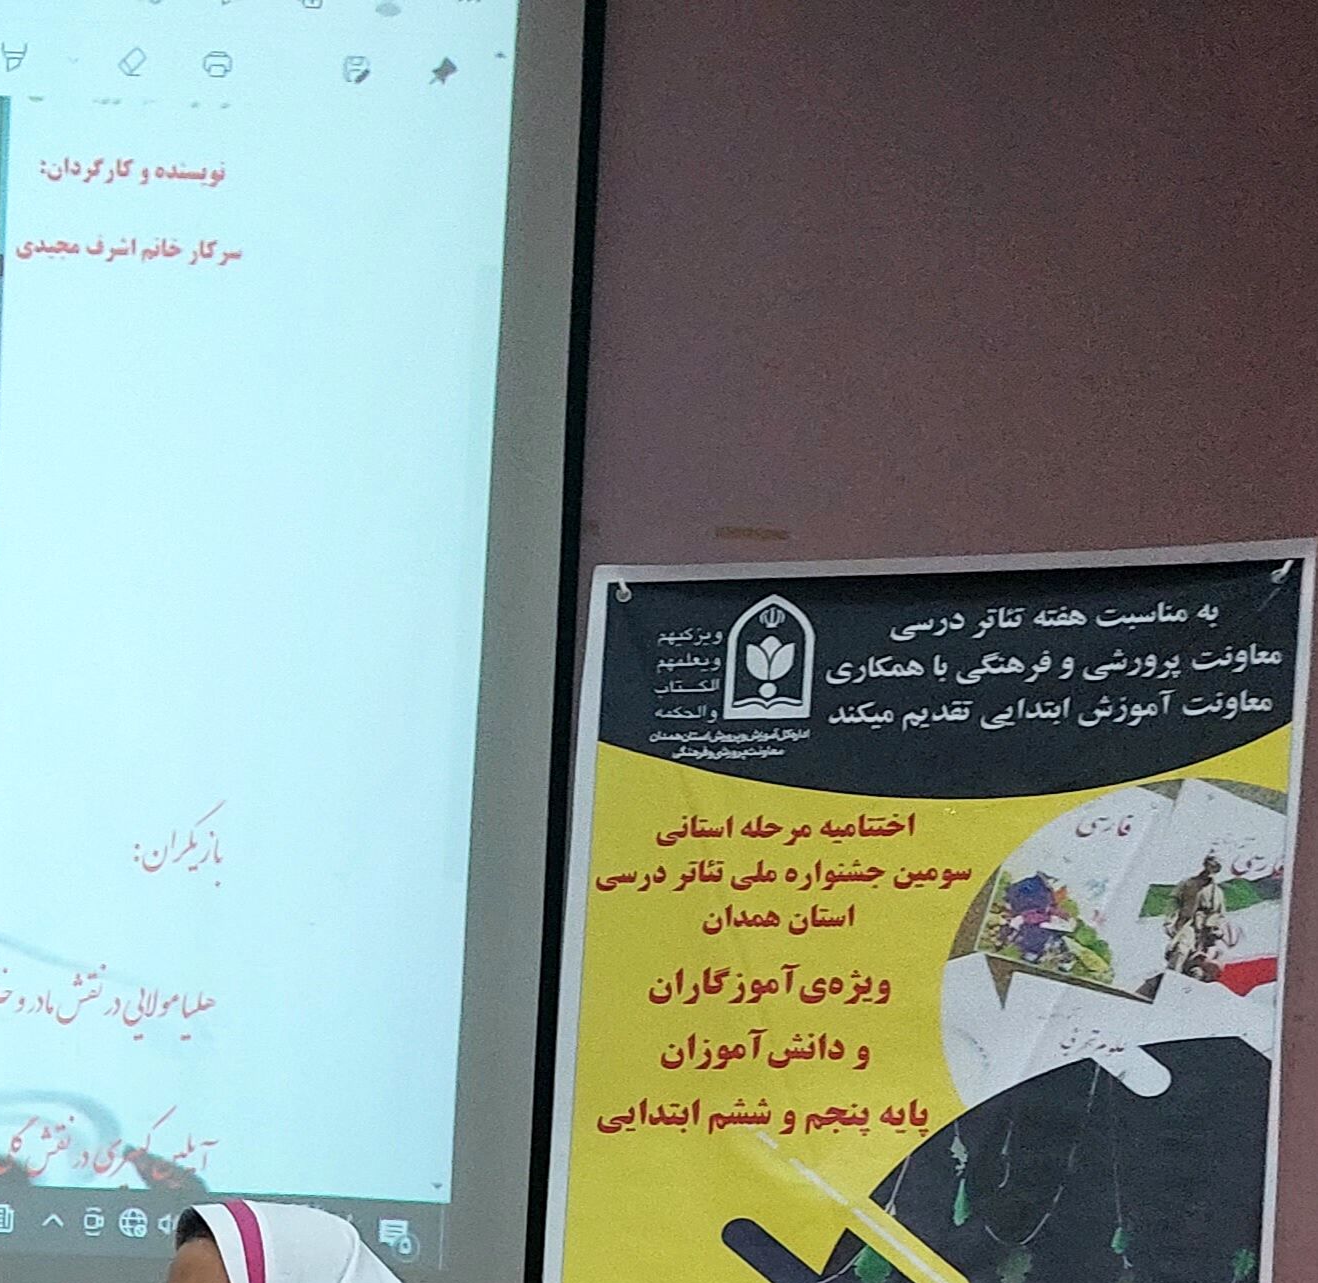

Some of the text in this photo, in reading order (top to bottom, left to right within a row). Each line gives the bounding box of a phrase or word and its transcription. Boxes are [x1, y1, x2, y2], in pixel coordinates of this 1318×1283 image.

[140, 166, 149, 184] و
[155, 161, 225, 187] نویسنده
[86, 235, 136, 262] اشرف
[141, 237, 181, 261] خانم
[890, 601, 1219, 641] به مناسبت هفته تئاتر درسی
[825, 642, 1283, 684] معاونت پرورشی و فرهنگی با همکاری
[827, 689, 1273, 731] معاونت آموزش ابتدایی تقدیم میکند
[656, 812, 916, 847] اختتامیه مرحله استانی
[595, 859, 972, 892] سومین جشنواره ملی تئاتر درسی
[702, 903, 855, 935] استان همدان
[648, 963, 800, 1005] آموزگاران
[852, 1043, 871, 1070] و
[597, 1098, 930, 1137] پایه پنجم و ششم ابتدایی
